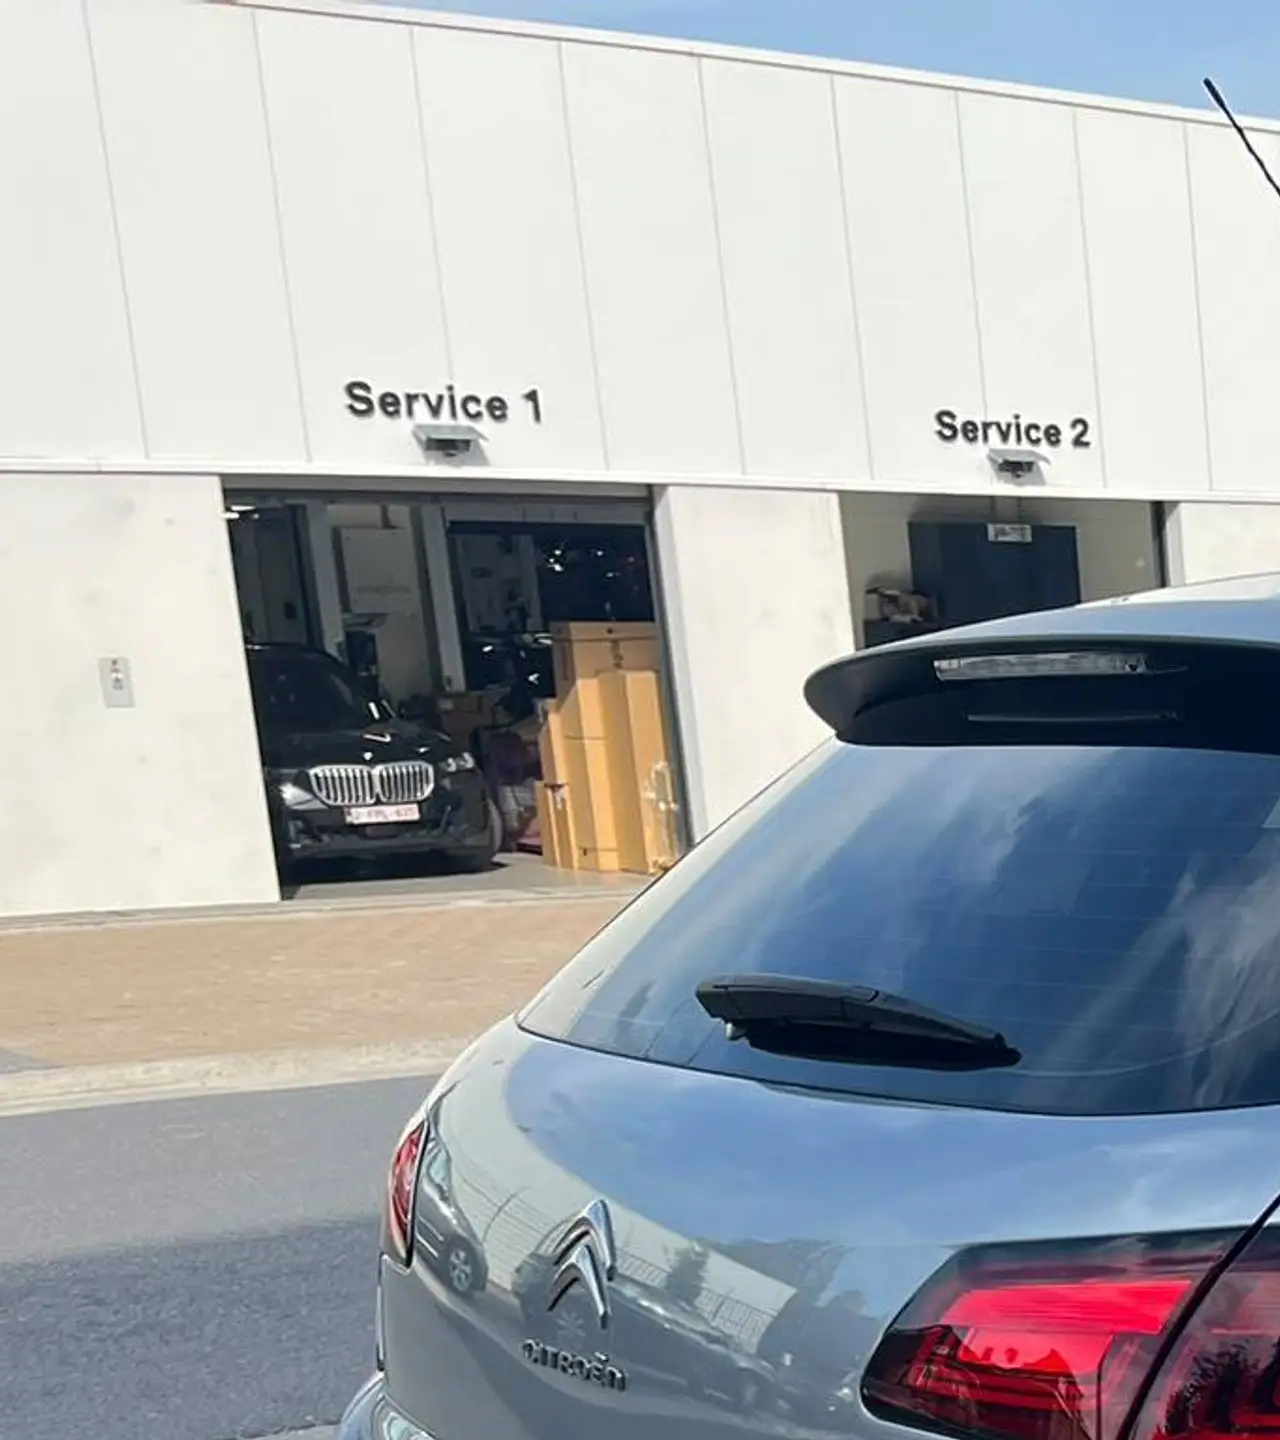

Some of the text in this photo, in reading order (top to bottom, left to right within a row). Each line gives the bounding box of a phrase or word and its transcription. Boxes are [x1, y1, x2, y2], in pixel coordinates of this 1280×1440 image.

[345, 381, 542, 424] Service 1
[934, 409, 1091, 448] Service 2
